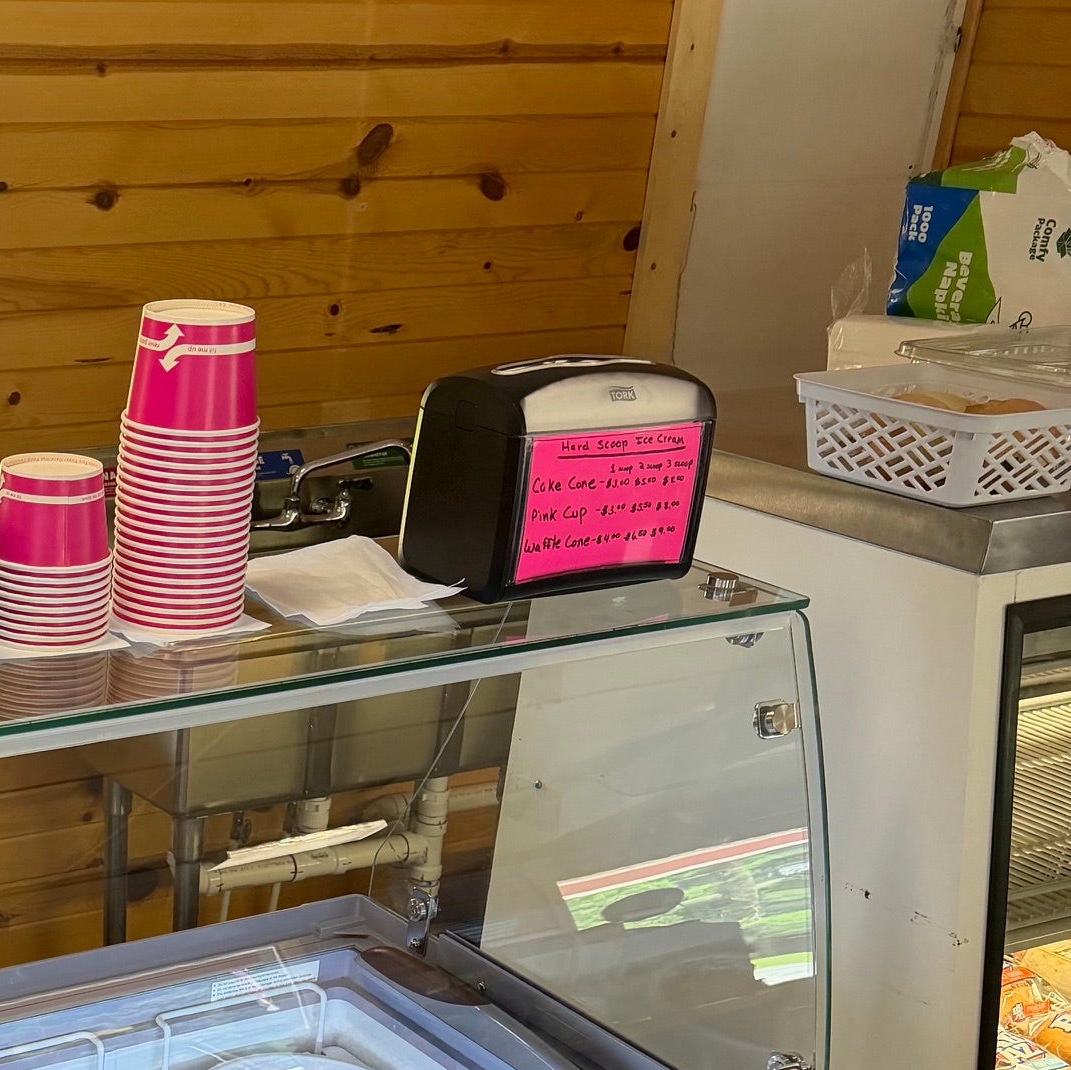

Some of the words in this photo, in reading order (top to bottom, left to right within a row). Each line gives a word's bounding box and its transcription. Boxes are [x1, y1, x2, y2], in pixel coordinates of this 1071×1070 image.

[908, 204, 923, 241] Pack
[917, 205, 934, 243] 1000
[1028, 217, 1046, 260] Package
[1035, 219, 1057, 262] Comfy
[611, 390, 636, 400] TORK
[561, 441, 590, 452] Hard
[597, 439, 629, 452] Scoop
[635, 436, 653, 445] Ice
[657, 433, 685, 445] Cream
[610, 464, 616, 473] 1
[639, 462, 645, 470] 2
[666, 459, 672, 468] 3
[532, 477, 562, 494] Cake
[568, 476, 597, 490] Cone
[531, 508, 557, 522] Pink
[563, 506, 588, 525] Cup
[524, 537, 561, 554] Waffle
